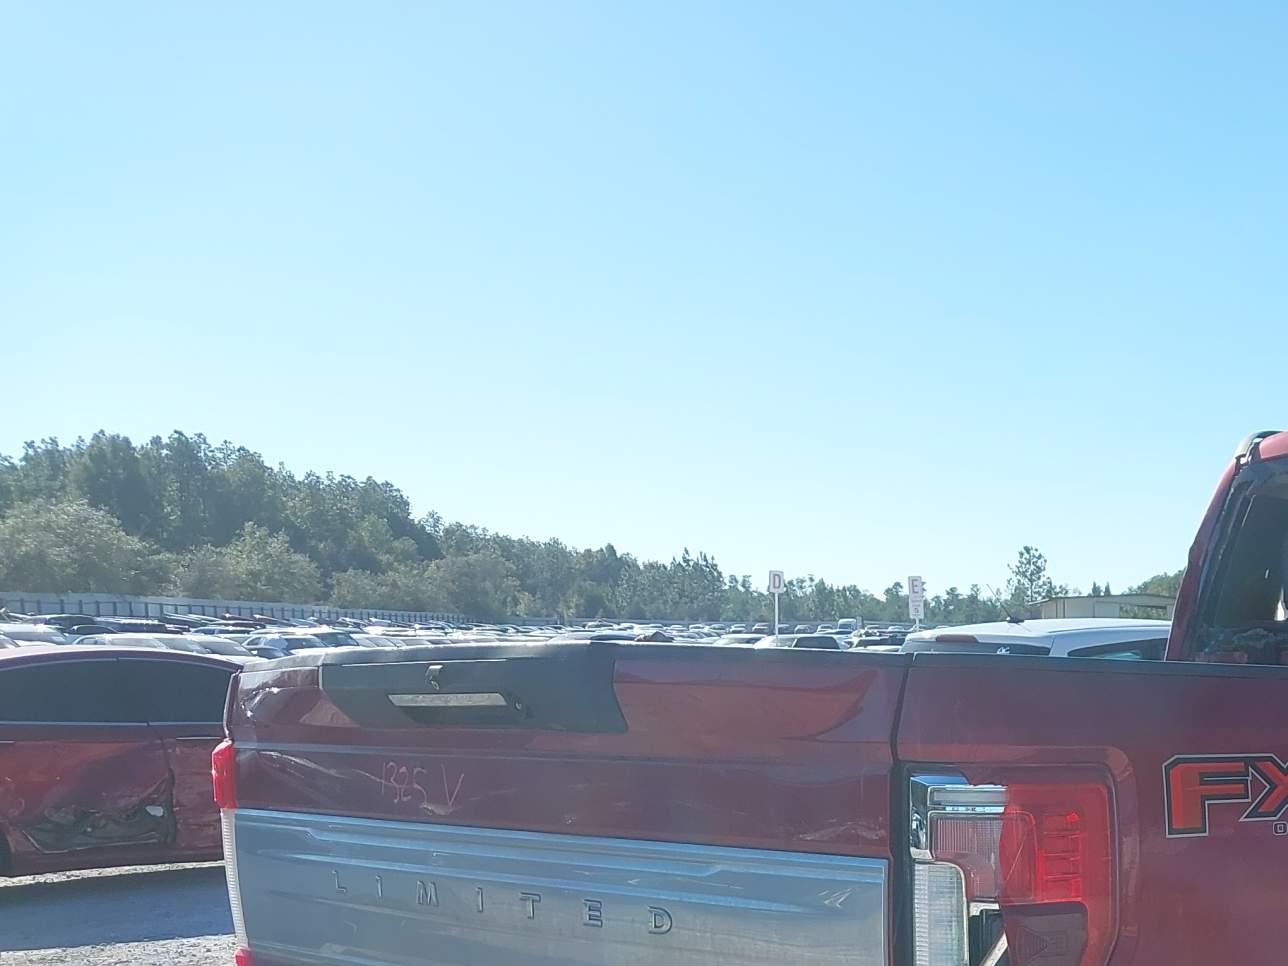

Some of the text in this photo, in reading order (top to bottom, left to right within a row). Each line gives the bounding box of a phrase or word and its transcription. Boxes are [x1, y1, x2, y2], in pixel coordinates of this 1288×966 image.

[772, 573, 782, 590] D
[911, 578, 920, 594] E
[331, 868, 674, 936] LIMITED
